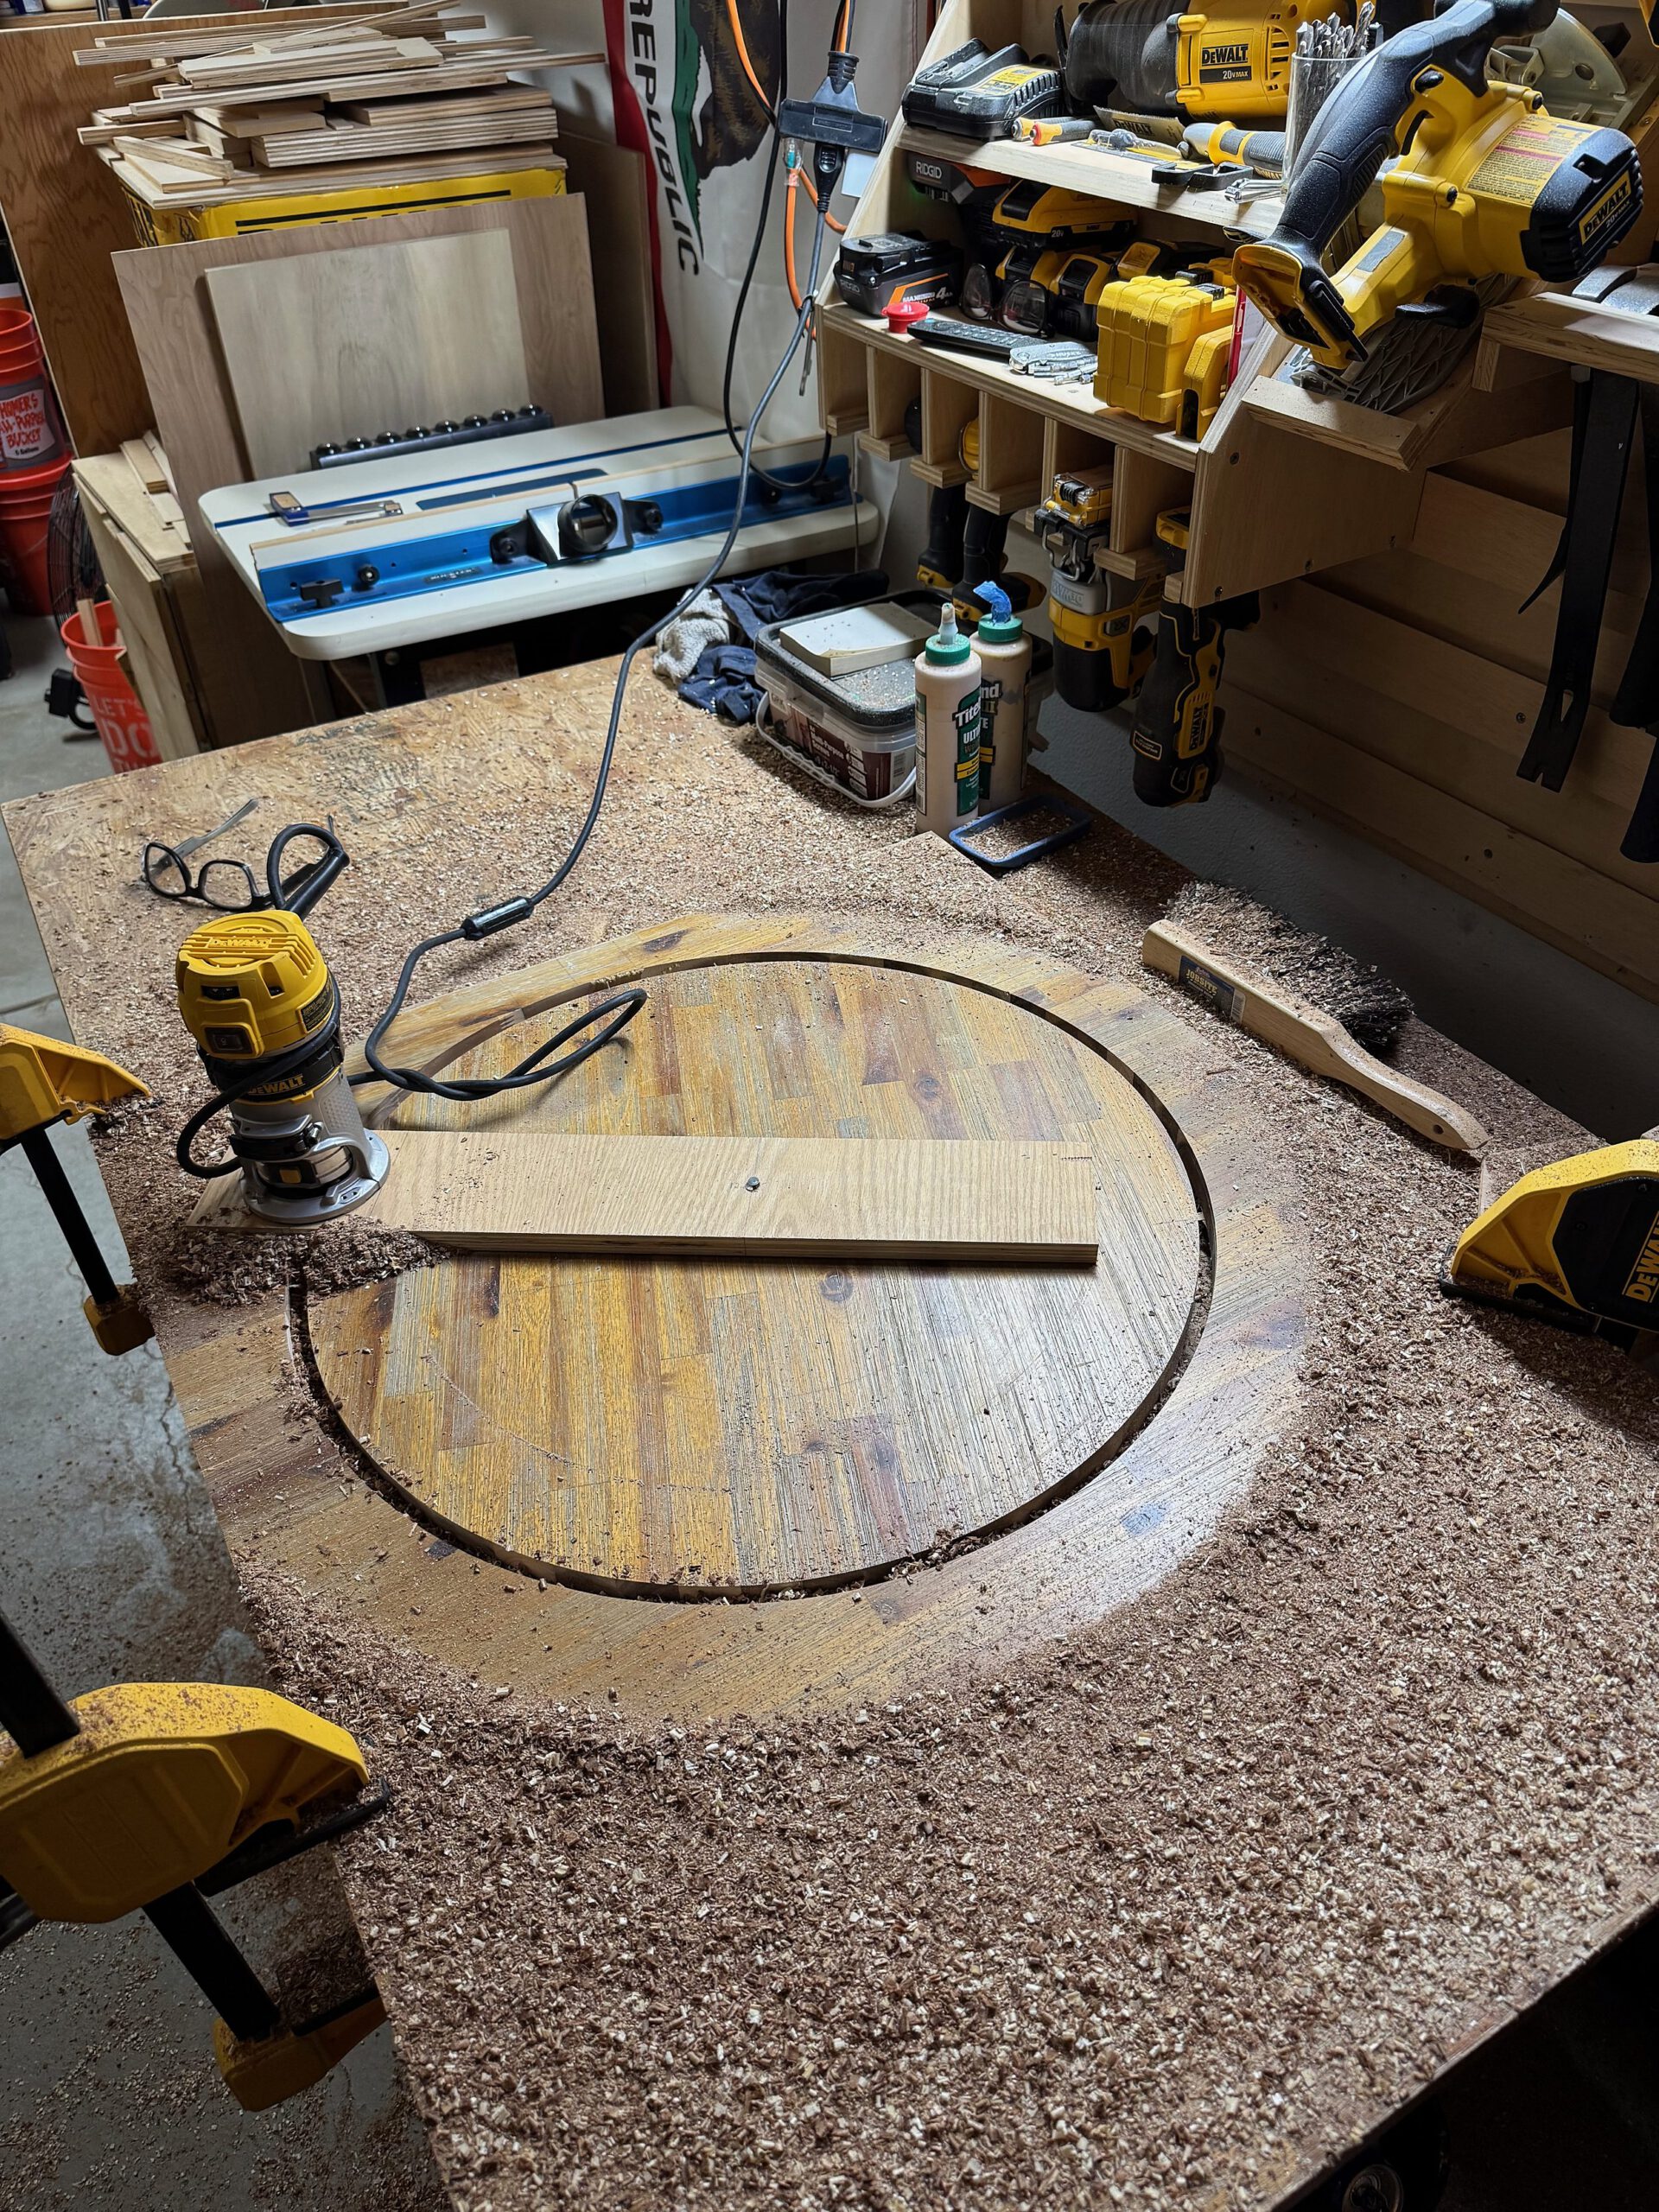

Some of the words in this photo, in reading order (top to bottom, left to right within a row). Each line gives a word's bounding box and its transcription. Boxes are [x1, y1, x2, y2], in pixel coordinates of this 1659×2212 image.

[630, 0, 699, 276] REPUBLIC
[916, 161, 942, 180] RIDGID
[1185, 969, 1217, 995] JOBSITE
